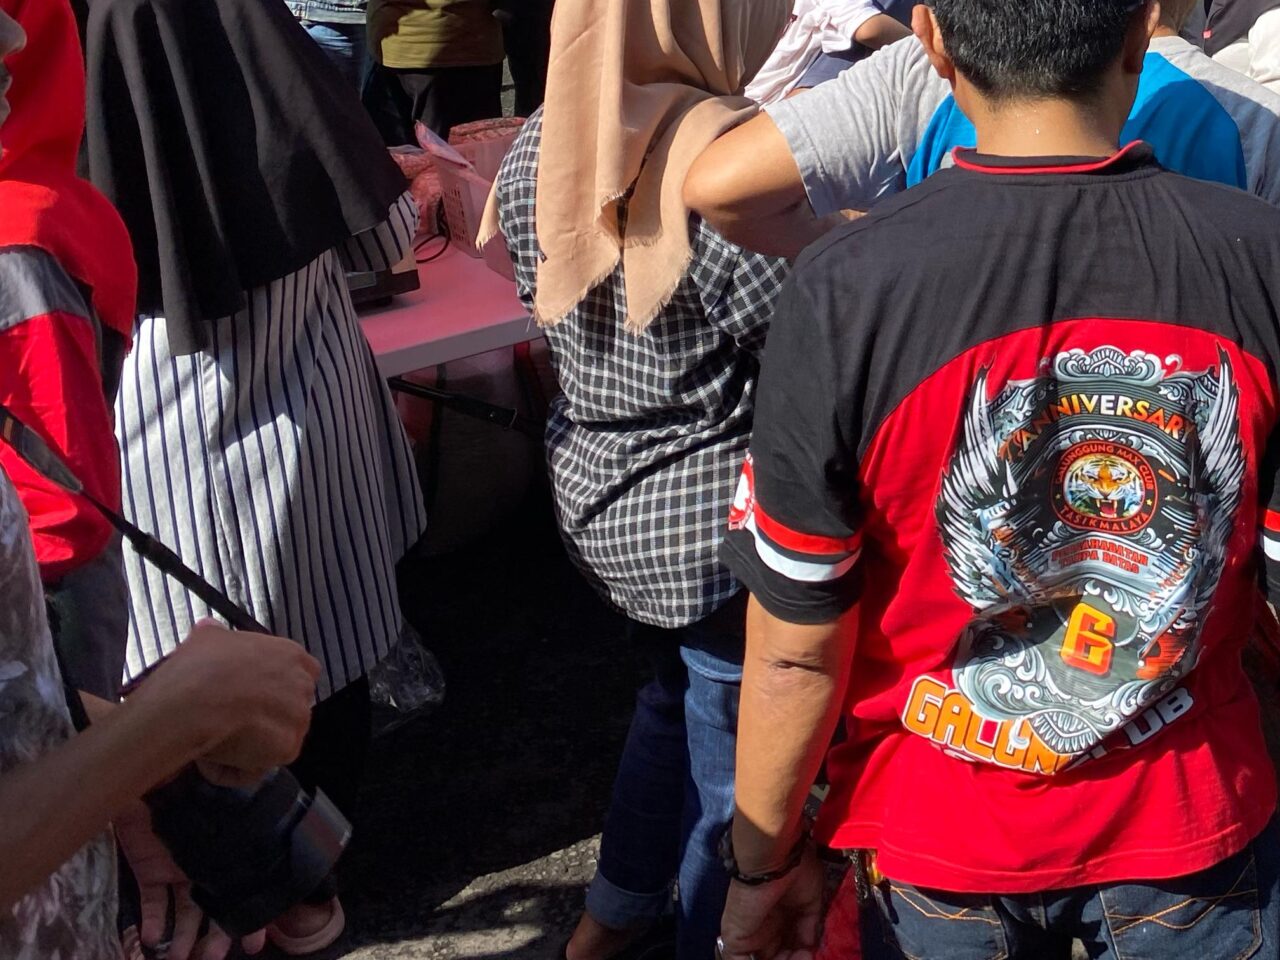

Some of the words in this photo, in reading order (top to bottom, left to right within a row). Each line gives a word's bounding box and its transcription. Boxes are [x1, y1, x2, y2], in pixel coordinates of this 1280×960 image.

[1055, 443, 1115, 485] GALUNGGUNG
[1117, 448, 1142, 467] MAX
[1139, 464, 1155, 491] CLUB
[1059, 505, 1149, 532] TASIKMALAYA
[1059, 602, 1116, 678] 6
[902, 675, 1072, 775] GALUN
